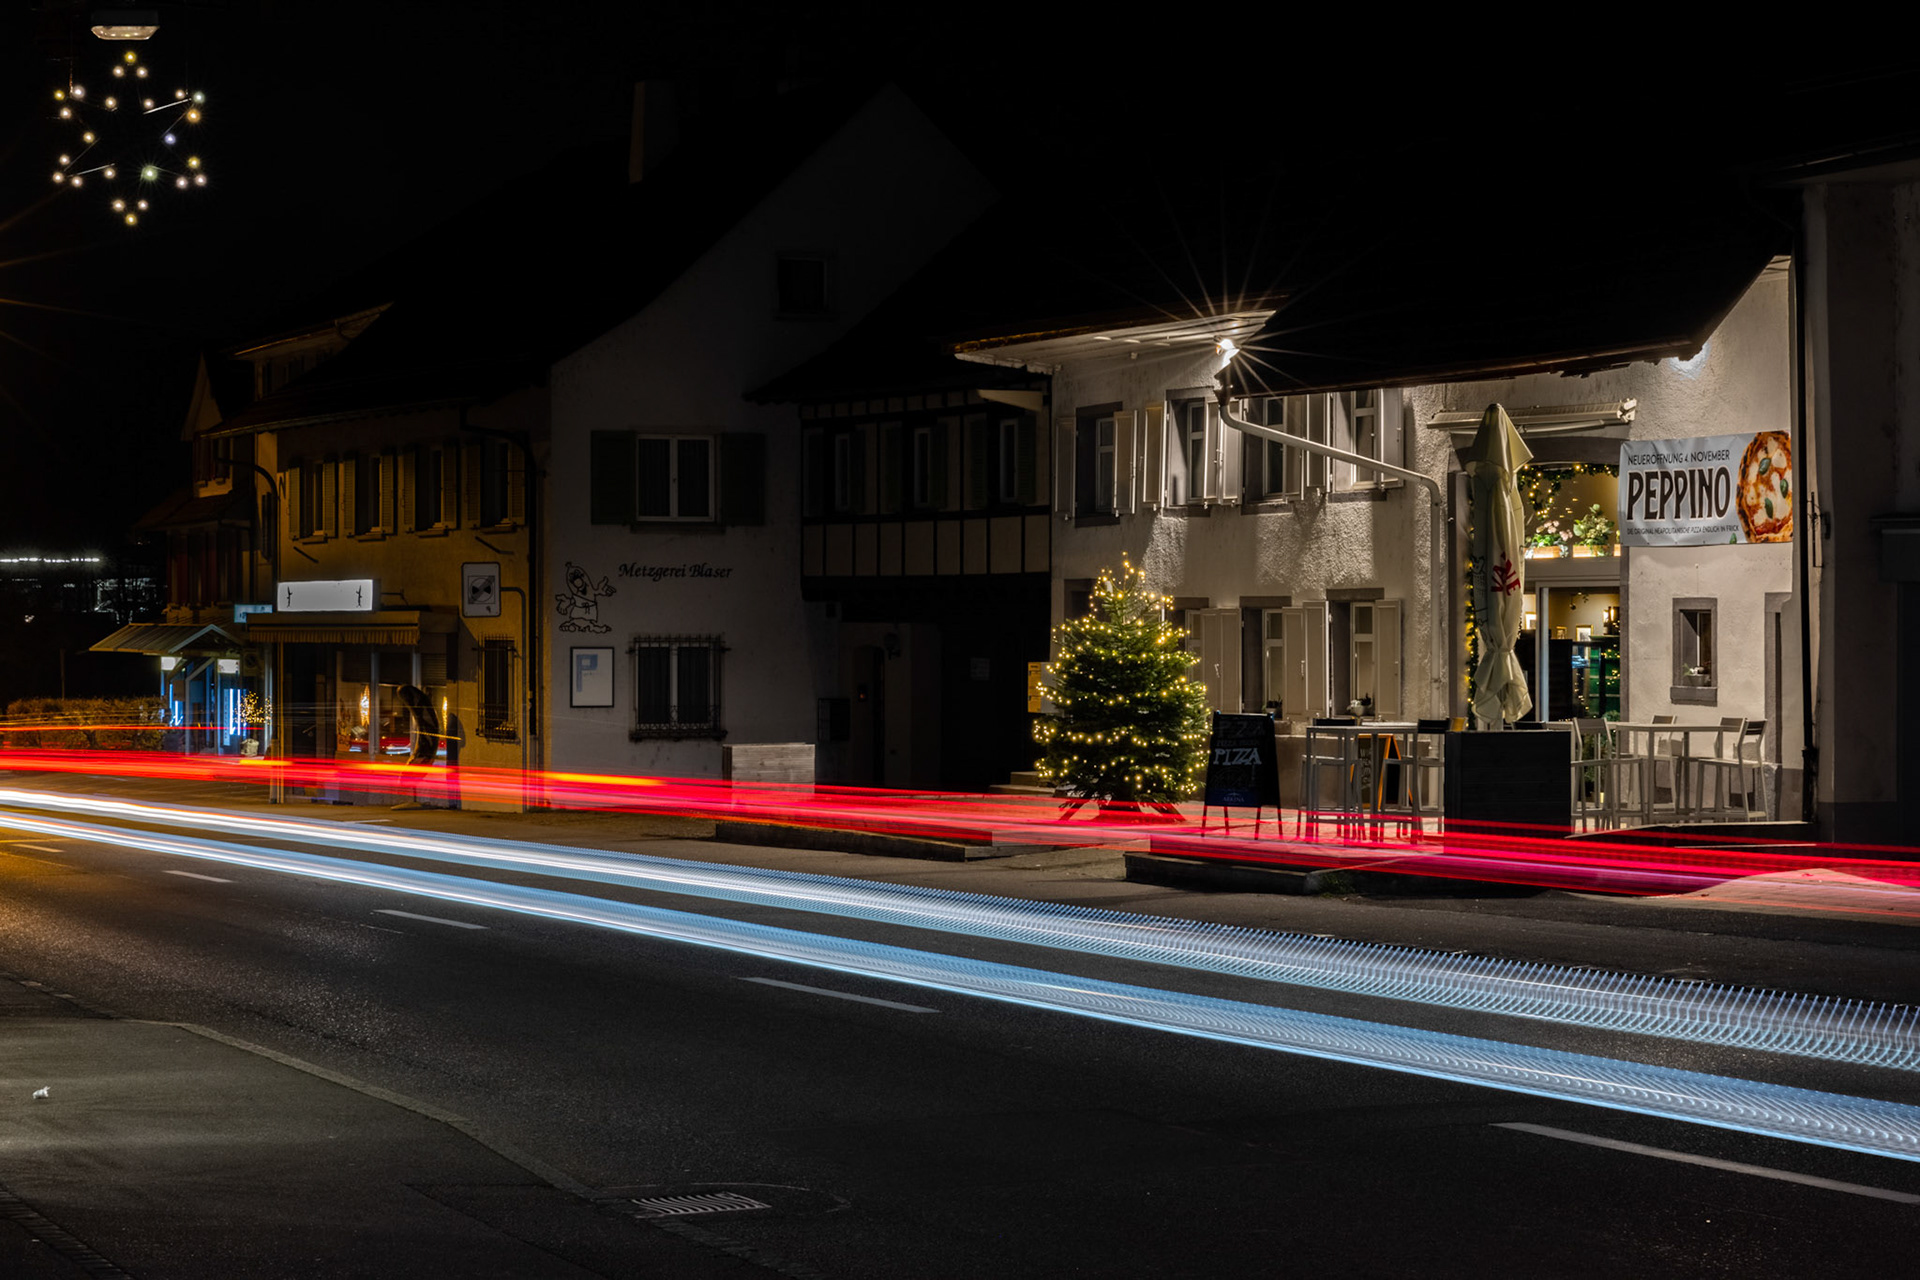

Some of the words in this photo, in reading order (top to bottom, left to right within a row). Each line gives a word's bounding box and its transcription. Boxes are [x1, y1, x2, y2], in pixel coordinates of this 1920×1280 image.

[1690, 449, 1731, 462] NOVEMBER
[1627, 466, 1732, 520] PEPPINO
[618, 562, 687, 582] Metzgerei
[689, 562, 734, 579] Blaser
[1213, 747, 1262, 766] PIZZA
